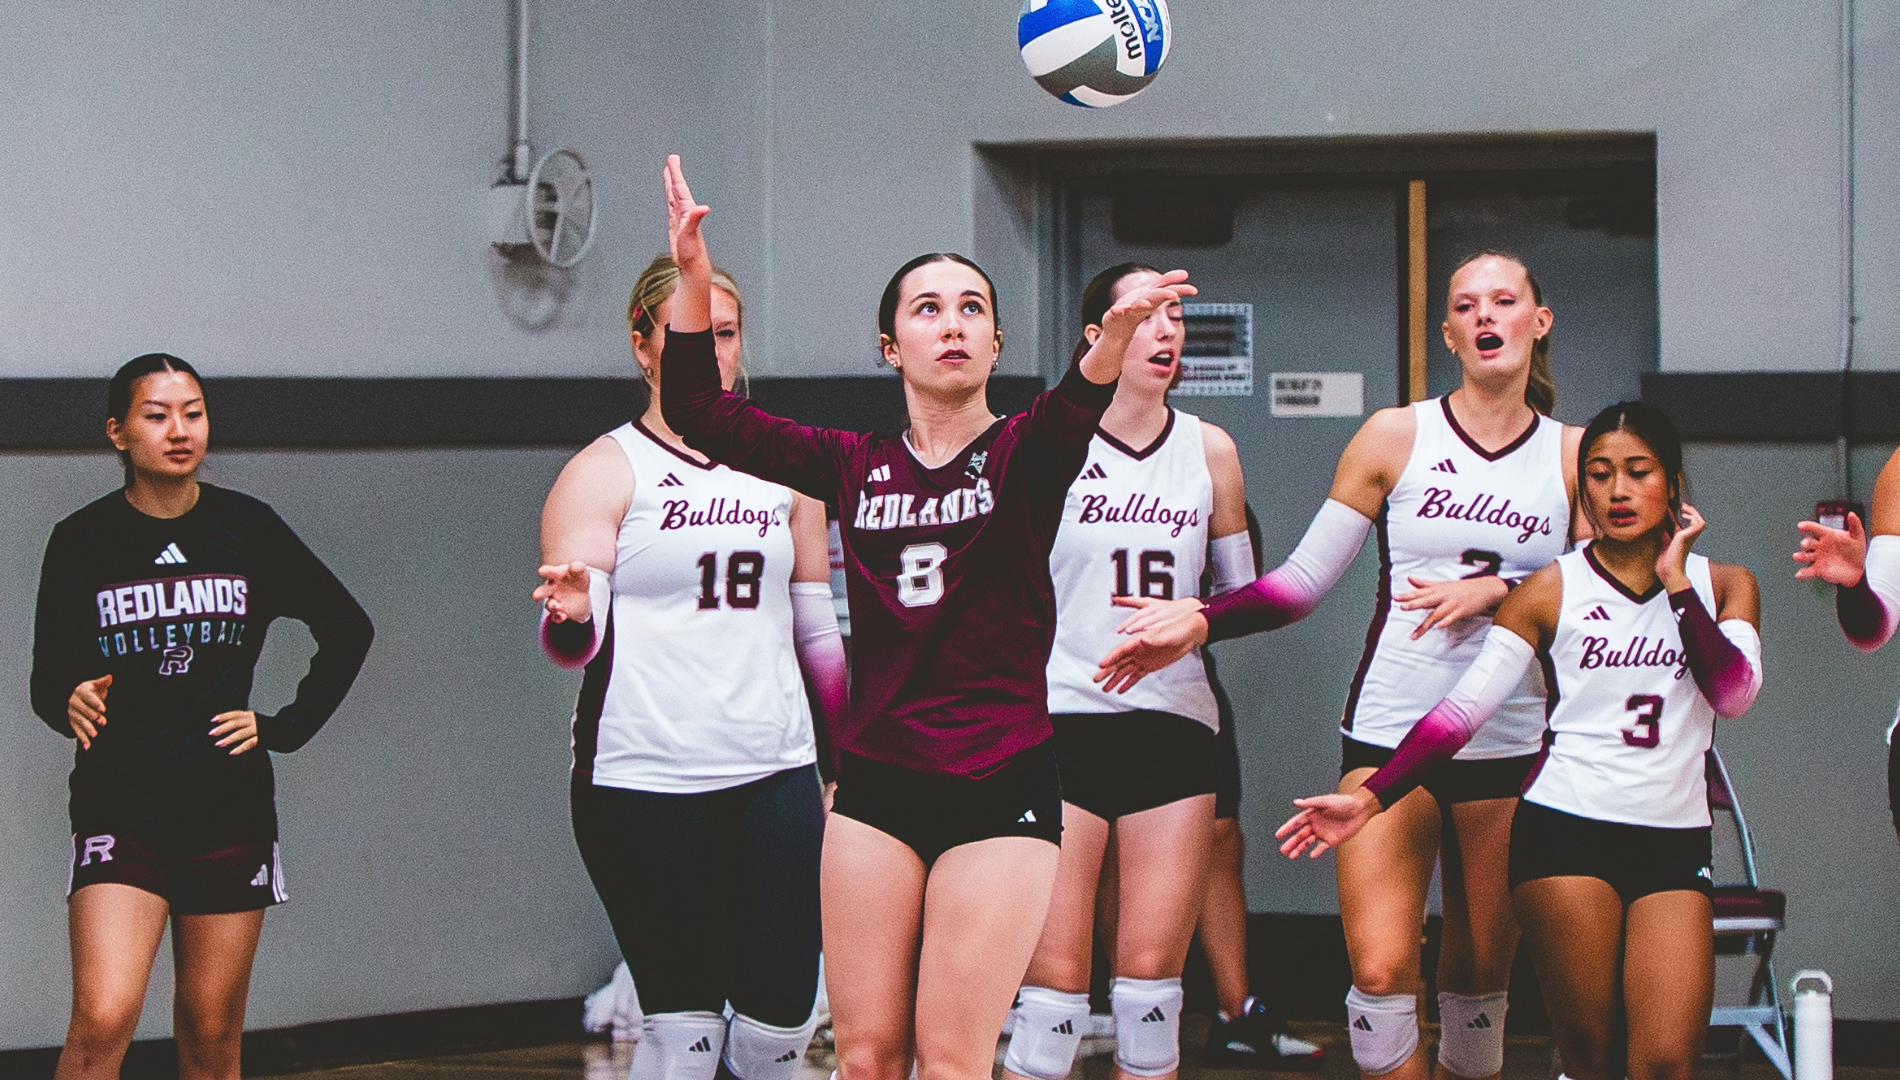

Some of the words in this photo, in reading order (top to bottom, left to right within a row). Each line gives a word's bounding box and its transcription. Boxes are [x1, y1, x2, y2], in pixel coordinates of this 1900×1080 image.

[1105, 0, 1142, 60] molte
[660, 497, 781, 538] Bulldogs
[853, 477, 995, 530] REDLANDS
[1078, 493, 1199, 538] Bulldogs
[1417, 487, 1552, 544] Bulldogs
[696, 550, 766, 612] 18
[896, 541, 948, 608] 8
[1110, 548, 1175, 606] 16
[96, 578, 248, 628] REDLANDS
[158, 645, 194, 676] R
[1579, 636, 1690, 680] Bulldog
[1621, 694, 1665, 749] 3
[80, 834, 116, 867] R
